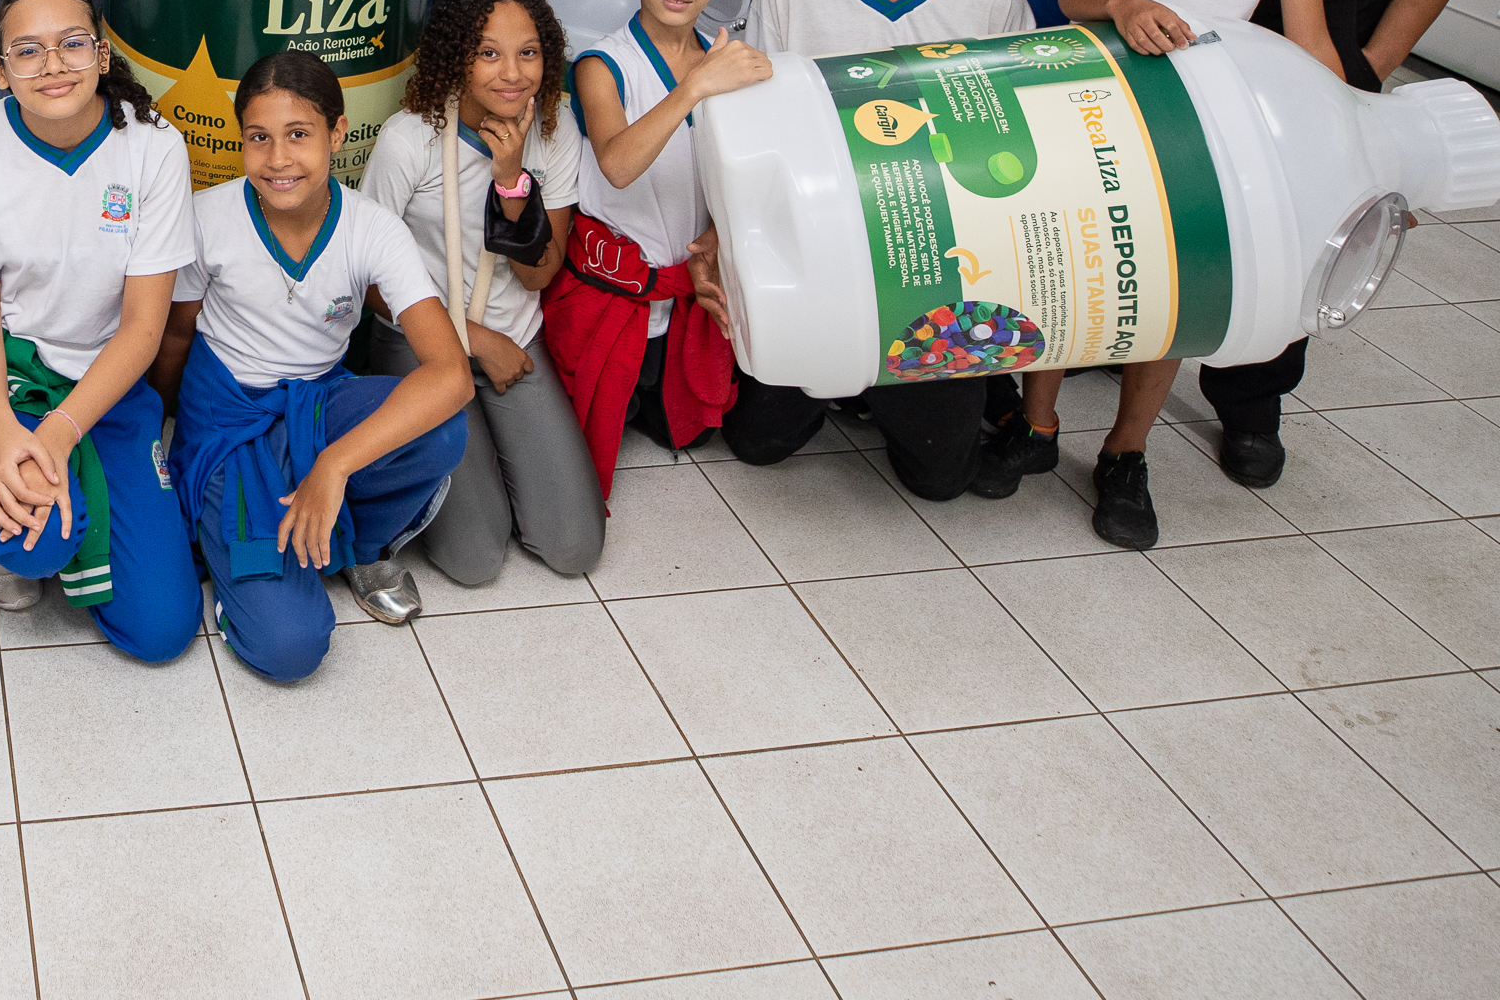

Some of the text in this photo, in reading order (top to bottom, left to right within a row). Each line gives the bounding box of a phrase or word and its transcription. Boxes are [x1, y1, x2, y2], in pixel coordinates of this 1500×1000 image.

[320, 46, 375, 63] ambiente
[323, 35, 366, 50] Renove
[934, 68, 963, 123] www.liza.com.br
[970, 57, 1011, 134] CONVERSE COMIGO EM:
[173, 105, 226, 129] Como
[874, 105, 897, 138] Cargill
[180, 130, 244, 154] ticipar
[194, 159, 211, 168] óleo
[212, 164, 239, 172] usado,
[880, 162, 895, 198] LIMPEZA
[870, 163, 897, 269] DE QUALQUER TAMANHO.
[891, 161, 921, 287] REFRIGERANTE, MATERIAL DE
[891, 209, 904, 245] HIGIENE
[902, 159, 918, 204] TAMPINHA
[912, 205, 926, 250] PLÁSTICA,
[923, 274, 932, 286] DE
[912, 159, 943, 285] AQUI VOCÊ PODE DESCARTAR:
[1030, 213, 1042, 255] ambiente,
[1040, 212, 1051, 249] conosco,
[1050, 211, 1058, 223] Ao
[1052, 226, 1064, 267] depositar
[1077, 208, 1103, 269] SUAS
[897, 247, 910, 288] PESSOAL,
[1020, 213, 1039, 307] apoiando ações sociais!
[1047, 251, 1055, 267] não
[1049, 268, 1057, 278] só
[1040, 275, 1049, 307] também
[1050, 279, 1059, 304] estará
[1105, 204, 1138, 361] DEPOSITE AQUI
[1041, 307, 1049, 329] estará
[1050, 304, 1059, 343] contribuindo
[1059, 290, 1068, 327] tampinhas
[1058, 329, 1066, 342] para
